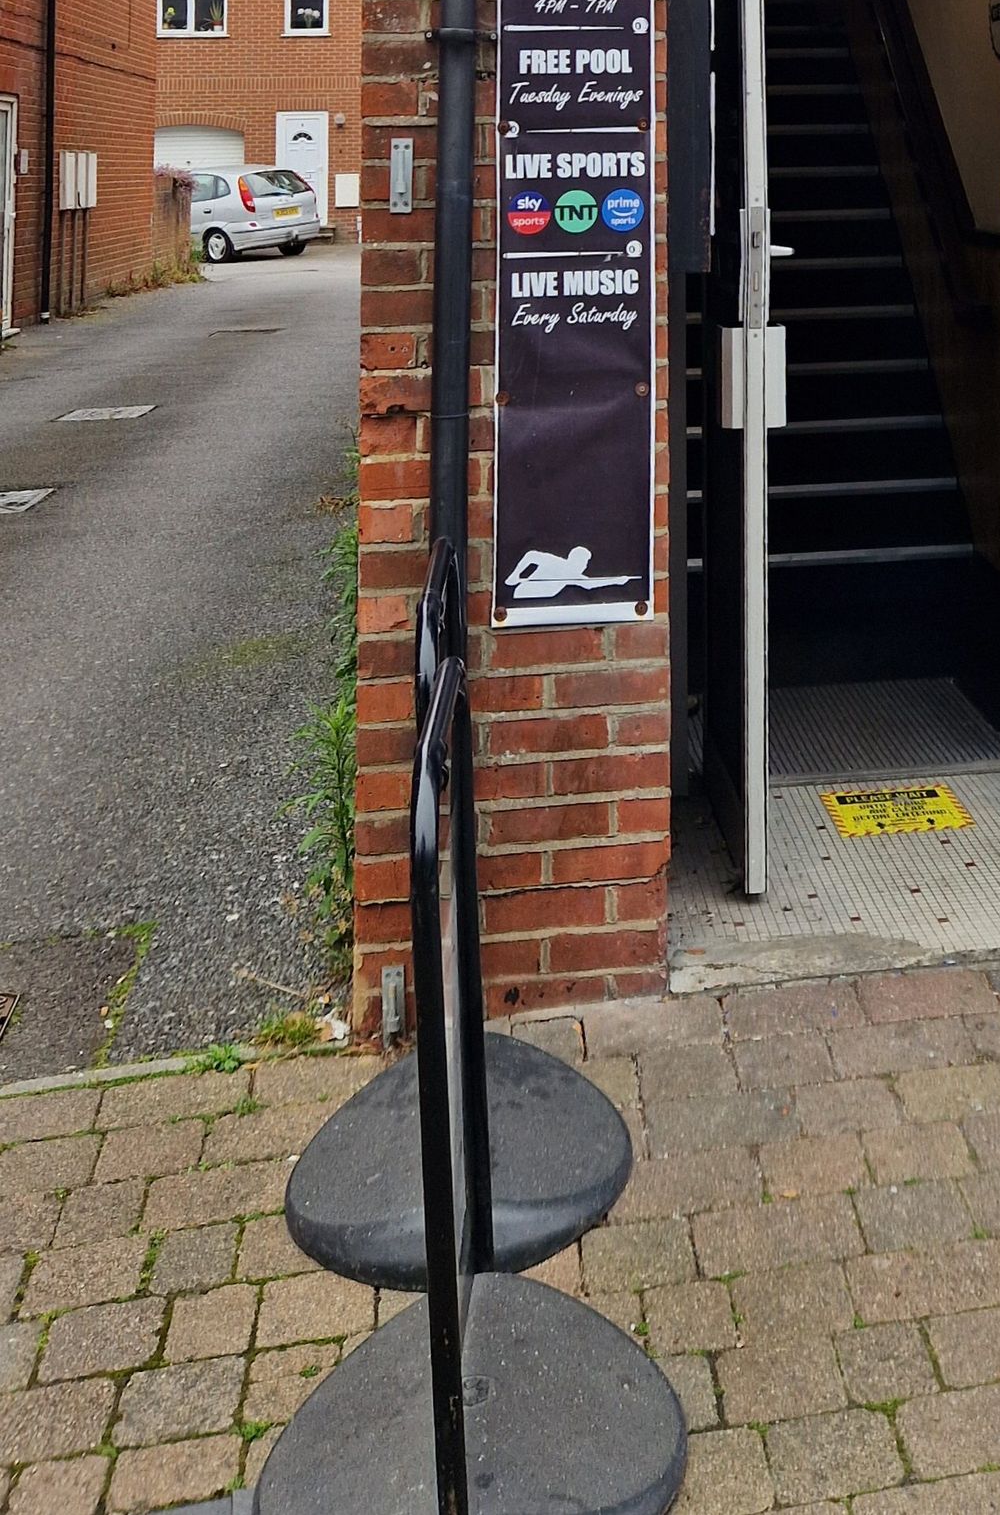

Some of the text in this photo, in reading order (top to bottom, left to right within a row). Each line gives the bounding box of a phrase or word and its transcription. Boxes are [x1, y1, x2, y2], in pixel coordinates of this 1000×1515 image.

[519, 49, 633, 75] FREE POOL
[508, 80, 644, 111] Tuesday Evenings
[505, 152, 646, 179] LIVE SPORTS
[517, 196, 542, 211] sky
[607, 196, 640, 210] prime
[555, 205, 598, 221] TNT
[512, 217, 545, 227] sports
[611, 217, 636, 226] sports
[511, 269, 640, 298] LIVE MUSIC
[511, 302, 637, 333] Every Saturday
[845, 791, 929, 804] PLEASE WAIT
